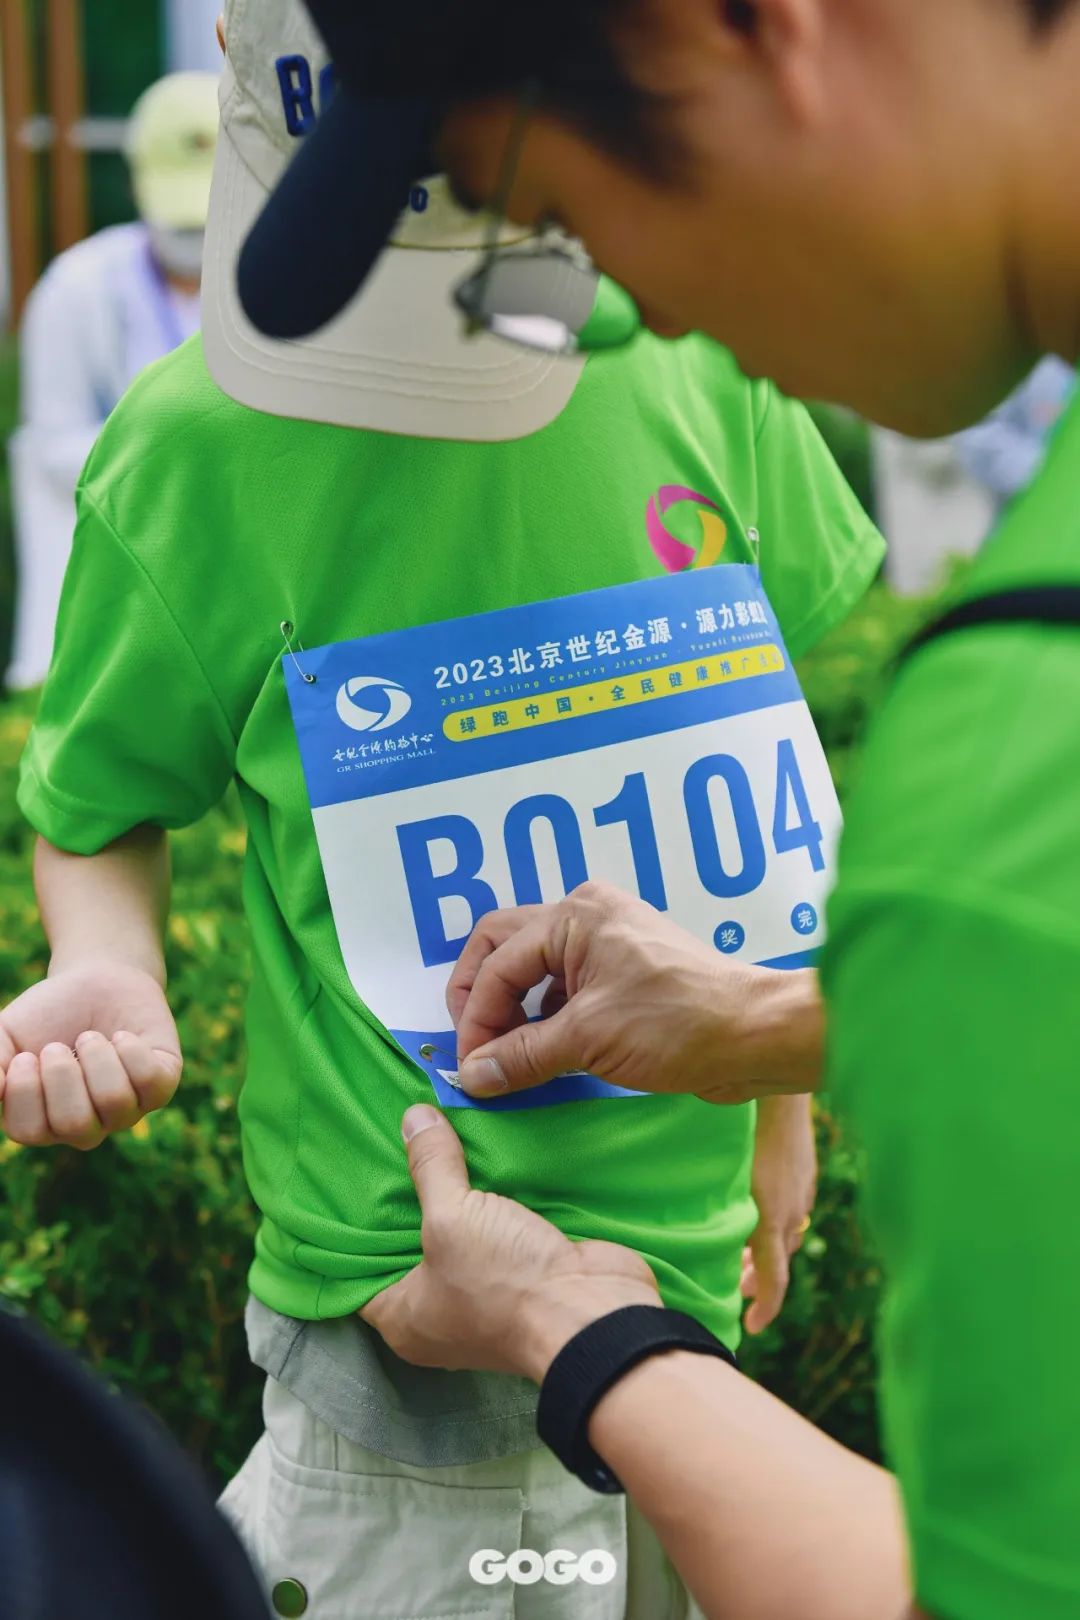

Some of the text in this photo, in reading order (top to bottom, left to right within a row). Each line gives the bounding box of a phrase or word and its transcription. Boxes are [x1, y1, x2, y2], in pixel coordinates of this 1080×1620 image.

[441, 692, 474, 706] 2023
[484, 680, 540, 697] Beijing
[549, 666, 606, 683] Century
[615, 652, 668, 669] Jinyuan
[336, 748, 437, 773] GR SHOPPING MALL
[395, 738, 826, 968] B0104
[797, 909, 814, 929] 完
[721, 928, 739, 948] 奖
